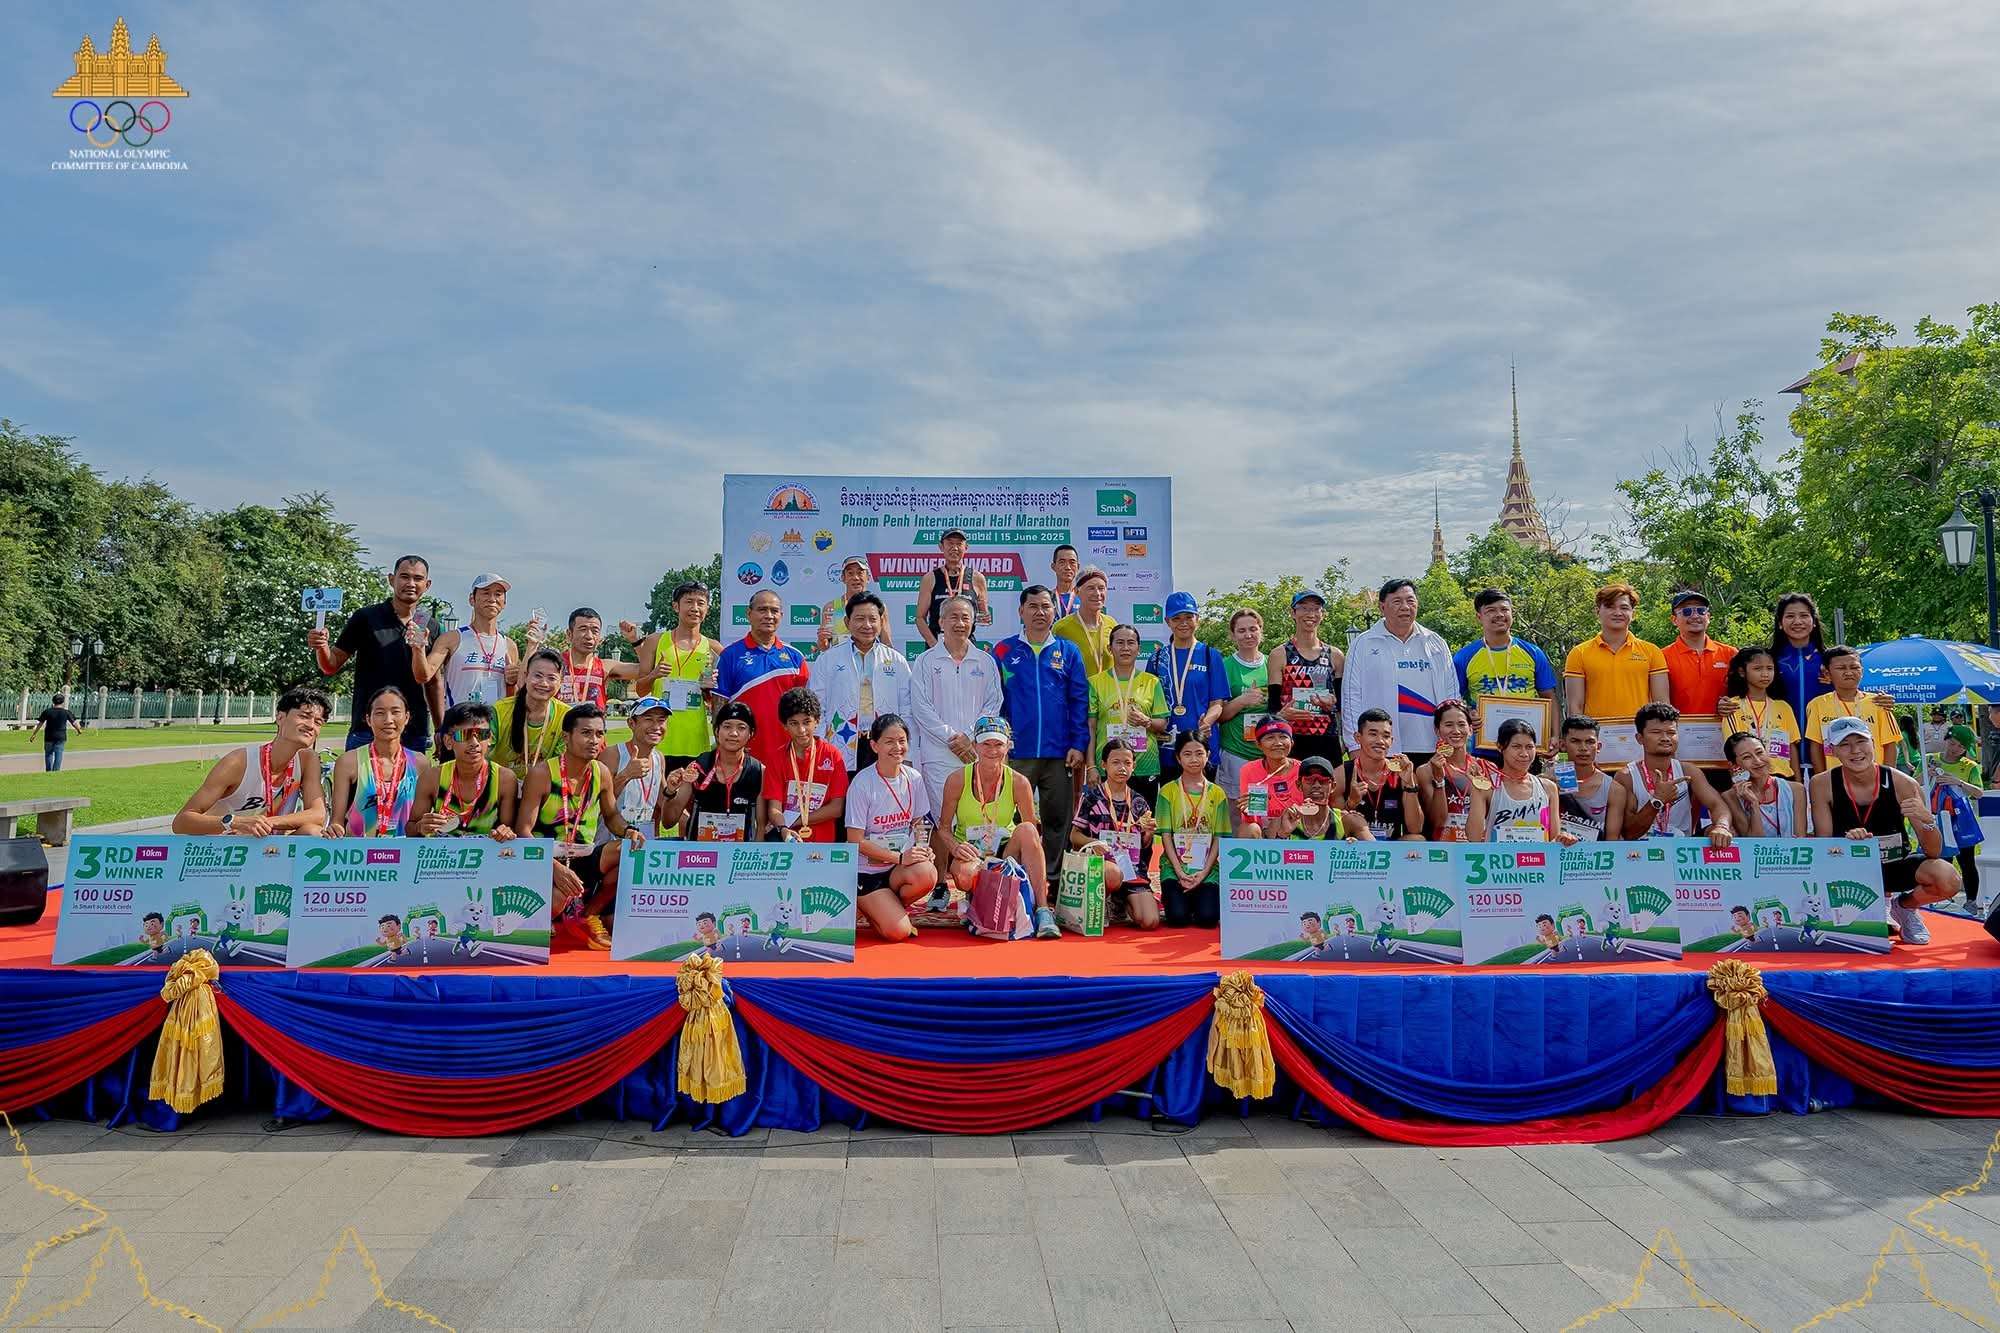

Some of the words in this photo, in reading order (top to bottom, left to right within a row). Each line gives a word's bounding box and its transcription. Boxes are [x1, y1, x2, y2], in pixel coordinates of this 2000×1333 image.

[1101, 504, 1128, 513] Smart
[841, 514, 879, 528] Phnom
[883, 514, 910, 528] Penh
[914, 514, 986, 527] International
[990, 514, 1013, 527] Half
[1016, 514, 1070, 527] Marathon
[1001, 532, 1011, 541] 15
[1013, 532, 1038, 541] June
[1040, 532, 1065, 541] 2025
[963, 558, 1013, 572] WARD
[793, 615, 815, 623] Smart
[1135, 614, 1157, 622] Smart
[1292, 665, 1328, 675] JAPAN
[142, 849, 162, 858] 10km
[223, 846, 248, 867] 13
[373, 852, 395, 861] 10km
[458, 848, 484, 869] 13
[685, 855, 710, 864] 10km
[1288, 853, 1309, 861] 21km
[1367, 850, 1391, 869] 13
[1521, 855, 1540, 863] 21km
[1676, 847, 1699, 864] ST
[1790, 846, 1814, 865] 13
[770, 851, 793, 870] 13
[1593, 850, 1614, 870] 13
[105, 867, 163, 879] WINNER
[334, 870, 397, 881] WINNER
[648, 872, 715, 886] WINNER
[1256, 869, 1314, 881] WINNER
[1492, 872, 1545, 884] WINNER
[1679, 868, 1742, 881] WINNER
[73, 889, 98, 901] 100
[103, 889, 133, 902] USD
[303, 892, 330, 904] 120
[335, 892, 367, 904] USD
[631, 894, 656, 905] 150
[660, 894, 689, 906] USD
[1230, 889, 1256, 901] 200
[1258, 889, 1287, 902] USD
[1468, 894, 1491, 905] 120
[1495, 893, 1522, 905] USD
[1675, 889, 1690, 900] 00
[1693, 889, 1721, 900] USD
